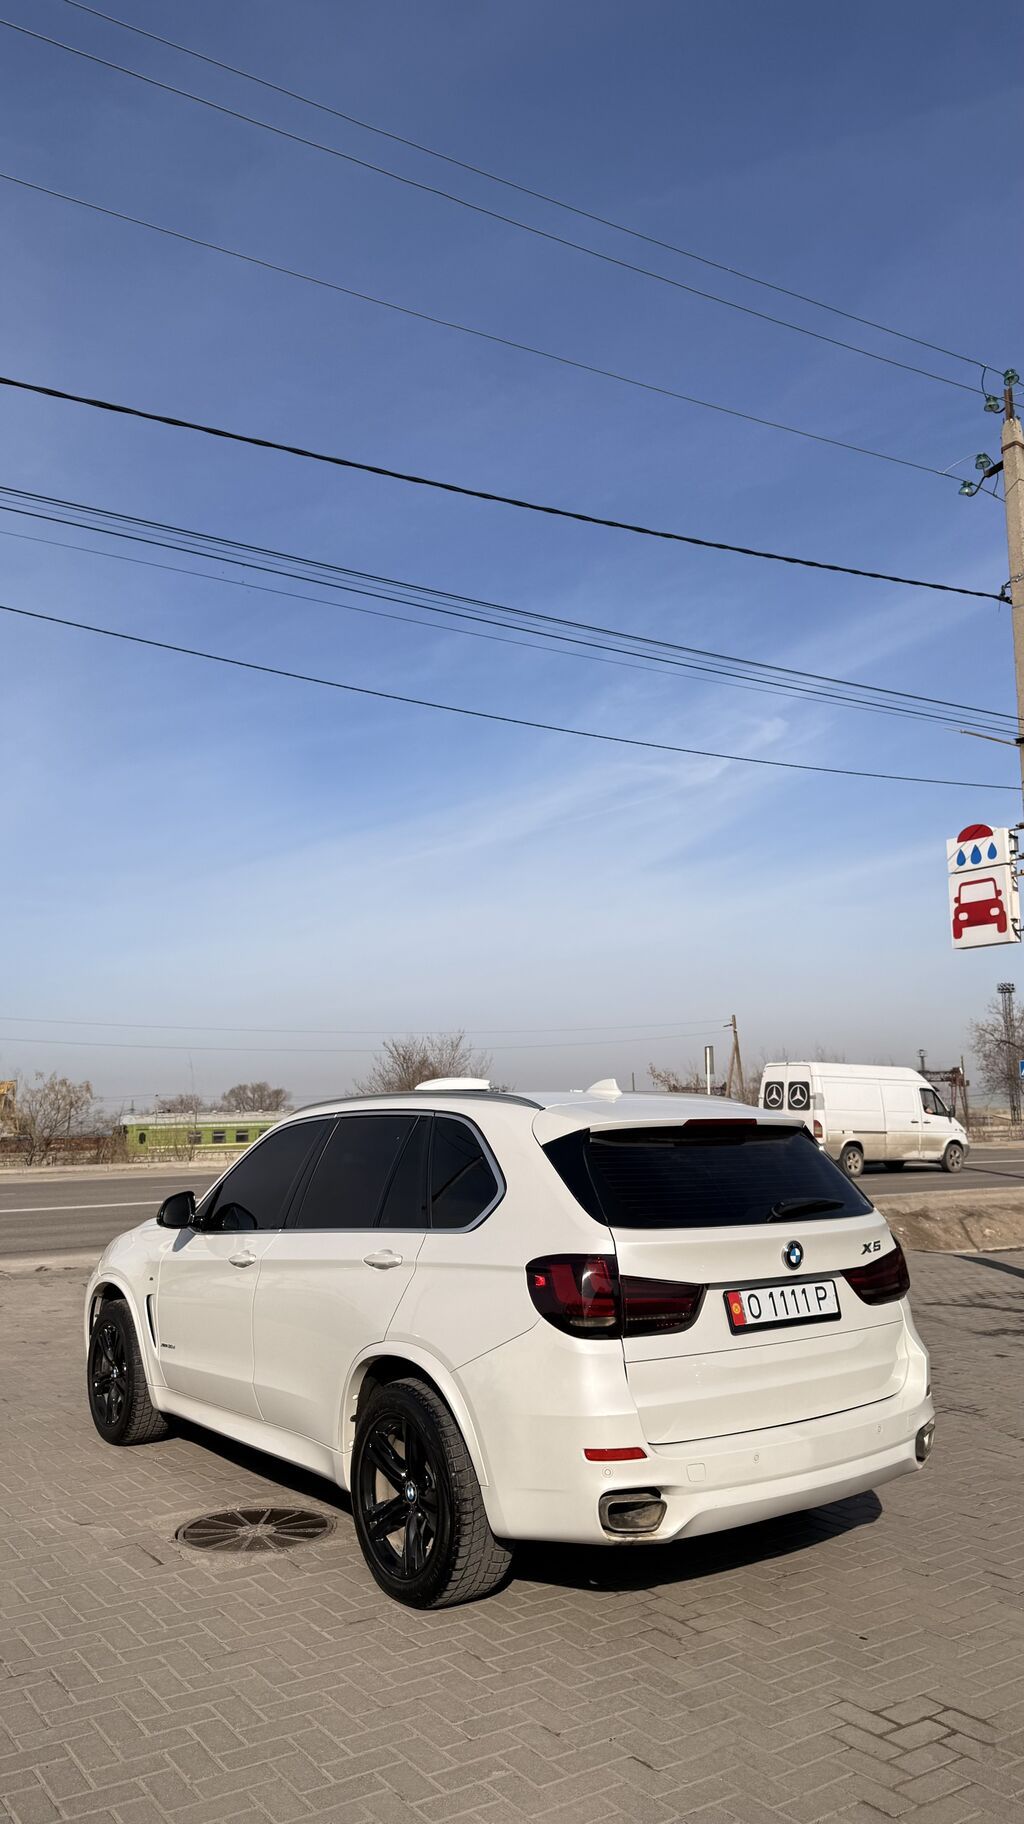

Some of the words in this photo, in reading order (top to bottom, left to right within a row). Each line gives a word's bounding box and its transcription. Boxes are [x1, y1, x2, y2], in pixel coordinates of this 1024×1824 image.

[861, 1240, 881, 1255] X5
[768, 1288, 811, 1317] 1111
[814, 1286, 827, 1311] P
